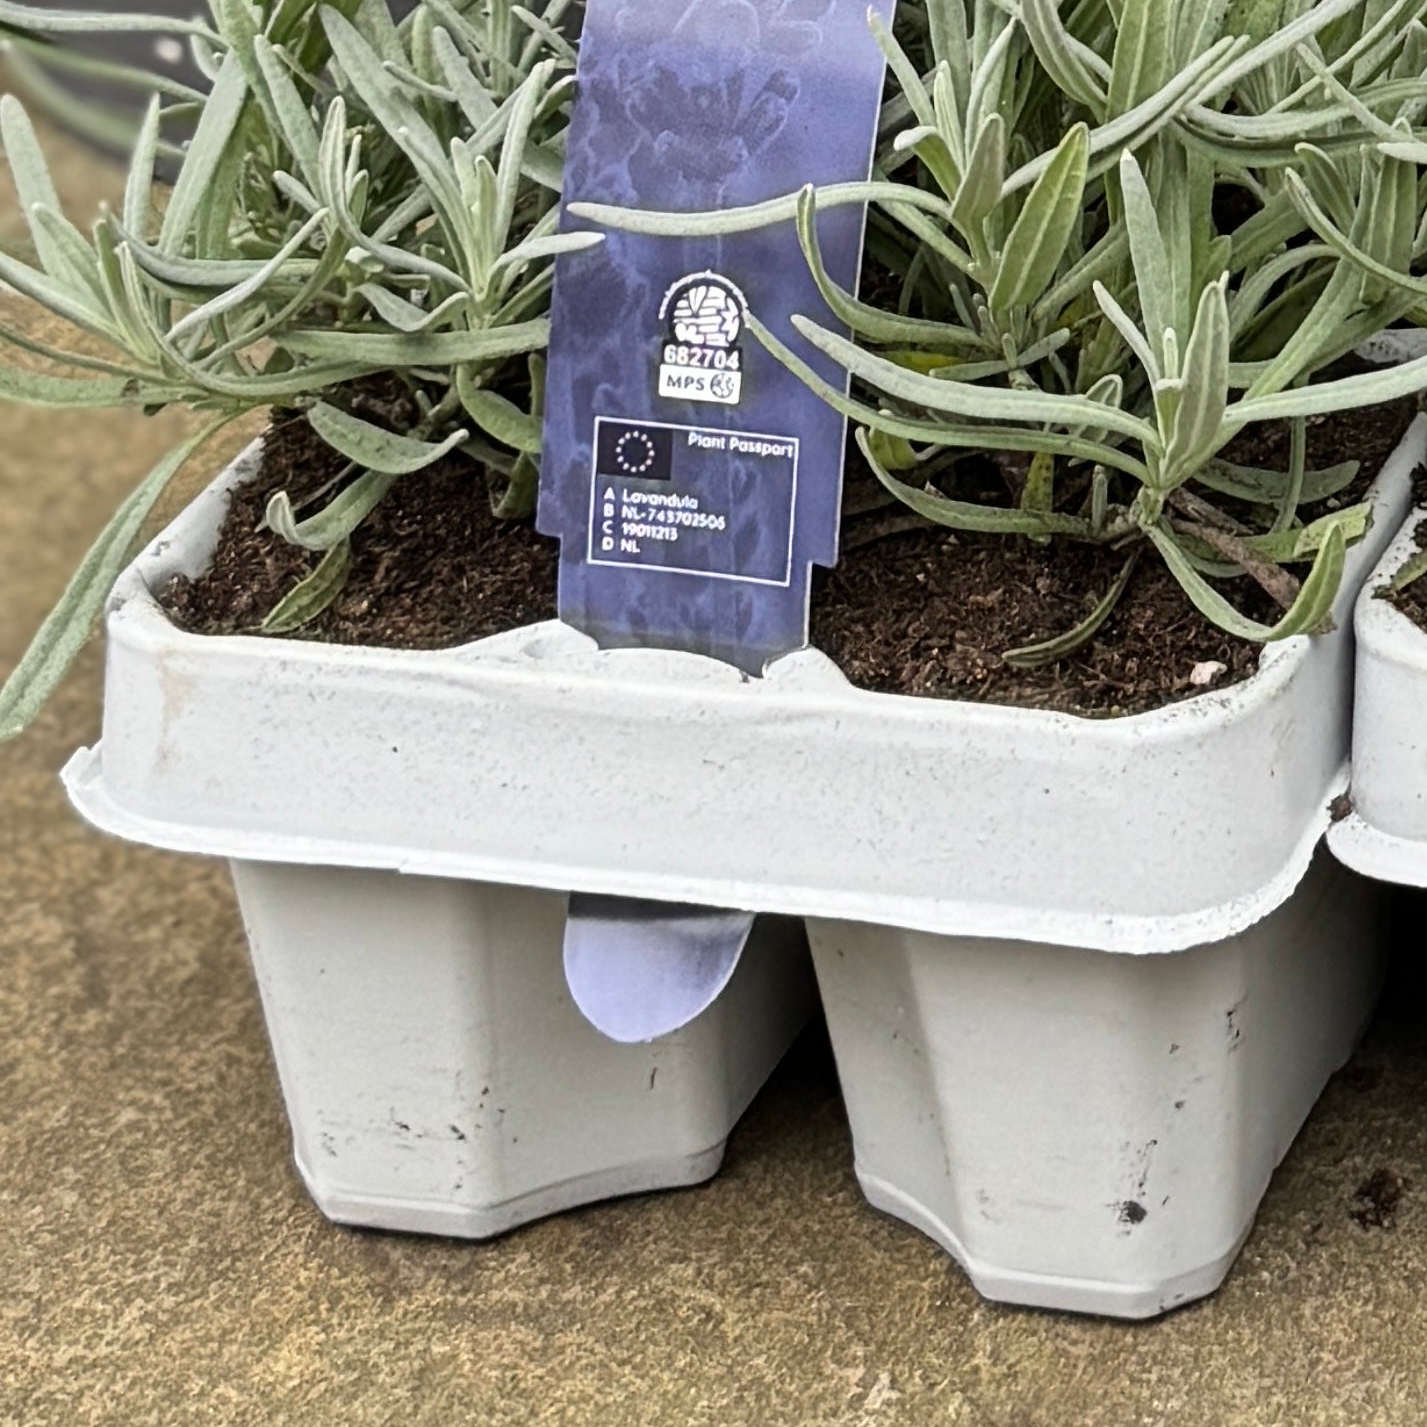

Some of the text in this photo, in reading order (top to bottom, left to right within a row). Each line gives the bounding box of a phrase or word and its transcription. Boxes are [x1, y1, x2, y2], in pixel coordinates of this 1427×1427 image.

[663, 344, 740, 370] 682704
[666, 374, 705, 391] MPS
[688, 431, 794, 458] Plant Passport
[603, 487, 699, 509] A Lavandula
[603, 503, 615, 517] B
[602, 520, 613, 534] C
[602, 536, 641, 553] D NL
